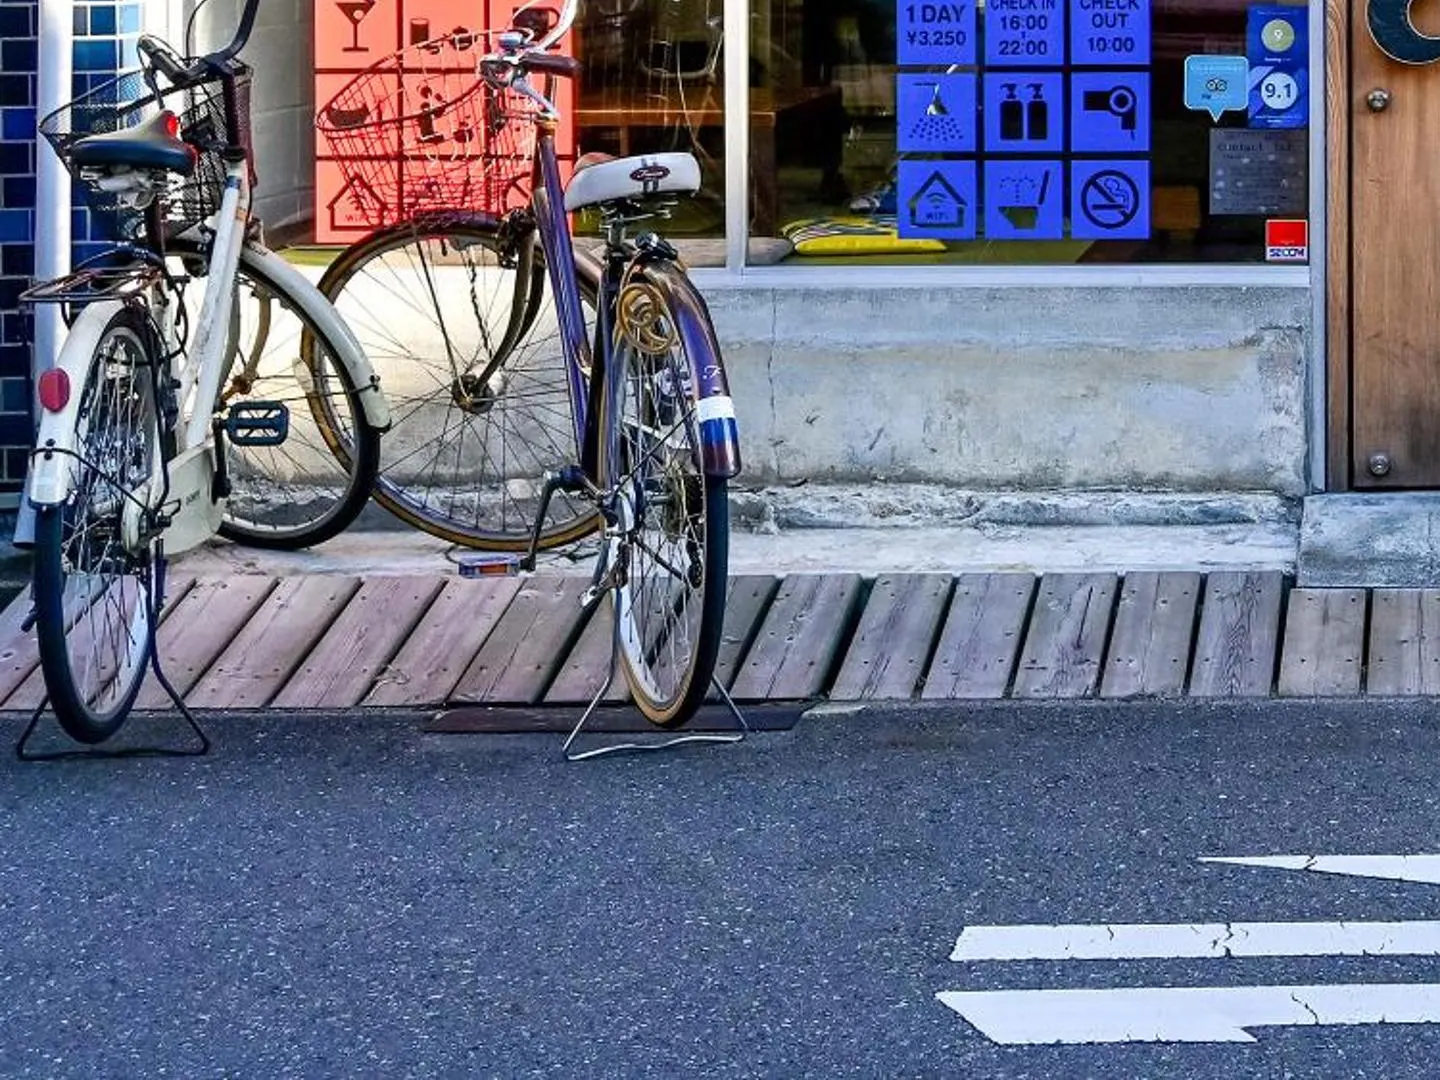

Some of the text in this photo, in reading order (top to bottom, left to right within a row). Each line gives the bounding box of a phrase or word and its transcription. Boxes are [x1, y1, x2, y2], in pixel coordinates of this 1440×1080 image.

[921, 5, 966, 23] DAY
[1091, 13, 1129, 29] OUT
[1000, 15, 1048, 30] 16:00
[999, 40, 1048, 56] 22:00
[1087, 37, 1135, 52] 10:00
[1264, 82, 1292, 99] 9.1
